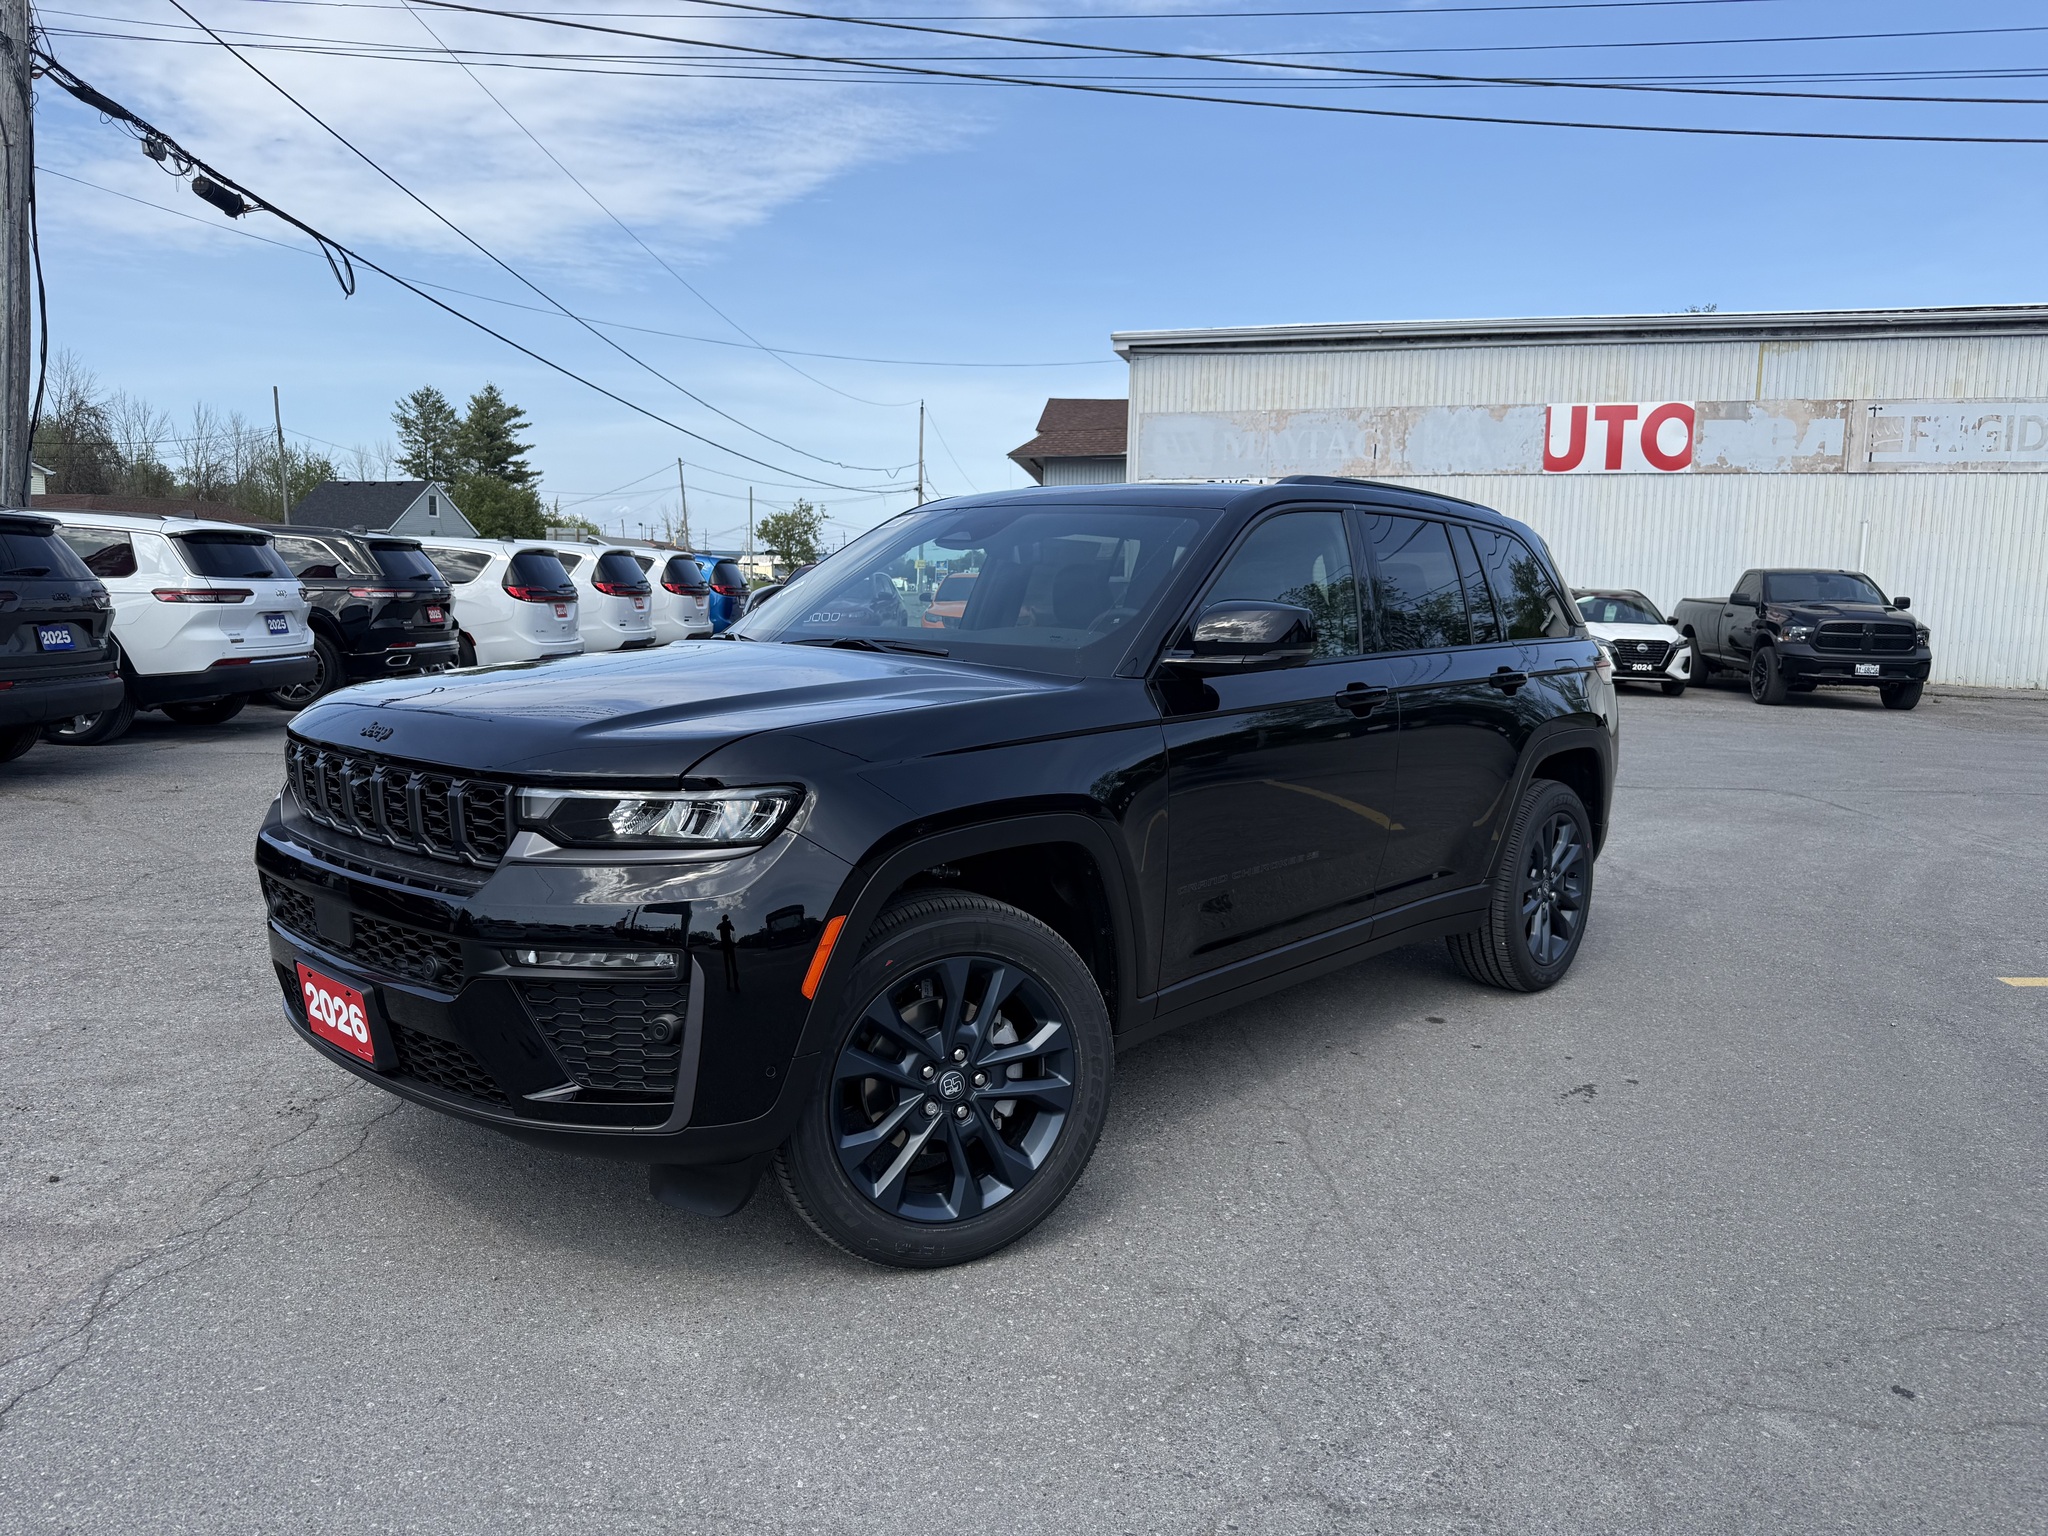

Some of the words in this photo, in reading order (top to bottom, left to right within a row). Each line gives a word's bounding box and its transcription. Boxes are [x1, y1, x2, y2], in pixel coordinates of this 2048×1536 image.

[1543, 402, 1693, 472] UTO
[1908, 414, 2048, 453] FGID
[268, 619, 287, 630] 2025
[40, 629, 72, 646] 2025
[1631, 663, 1653, 672] 2024
[359, 721, 395, 743] Jeep
[304, 981, 369, 1044] 2026
